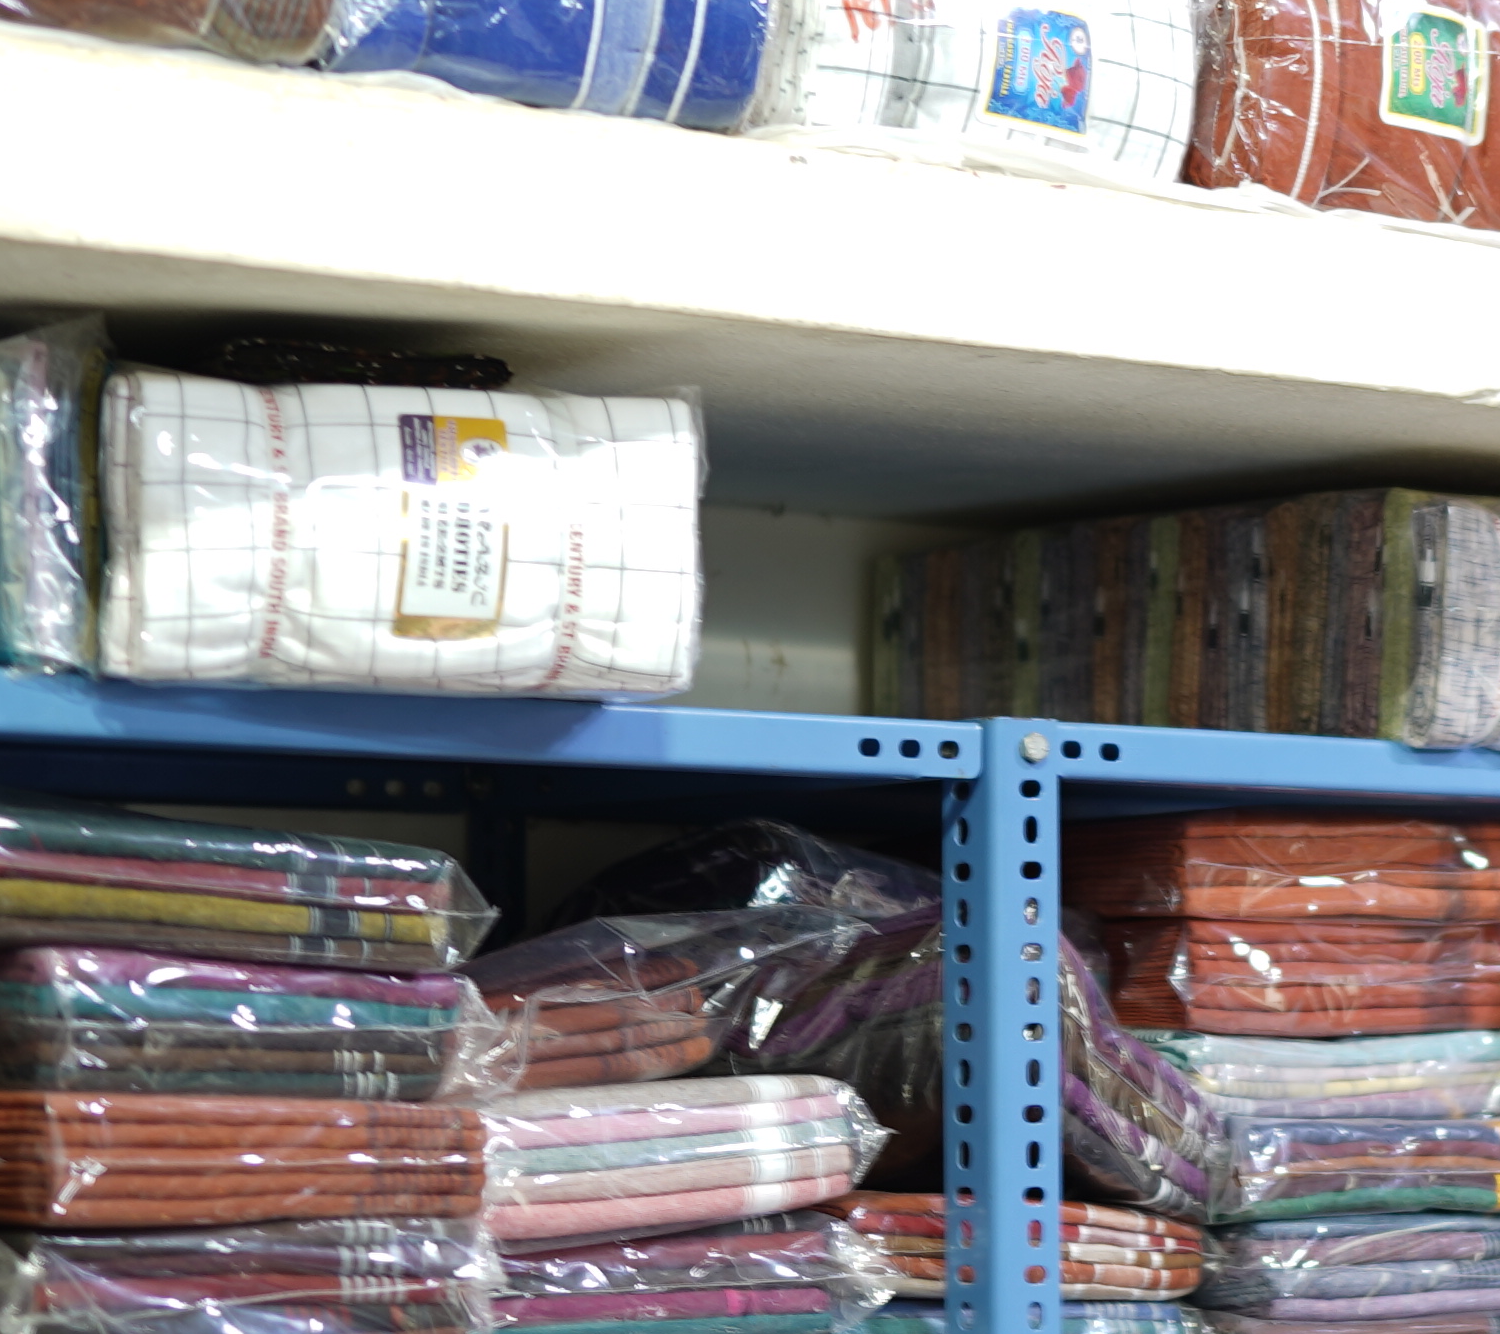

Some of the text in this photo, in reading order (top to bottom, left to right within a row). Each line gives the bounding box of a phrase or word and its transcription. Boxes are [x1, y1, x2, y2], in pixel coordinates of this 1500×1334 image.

[1032, 23, 1067, 109] Roja
[1425, 28, 1455, 109] Roja
[272, 492, 289, 551] BRAND
[268, 557, 287, 613] SOUTH
